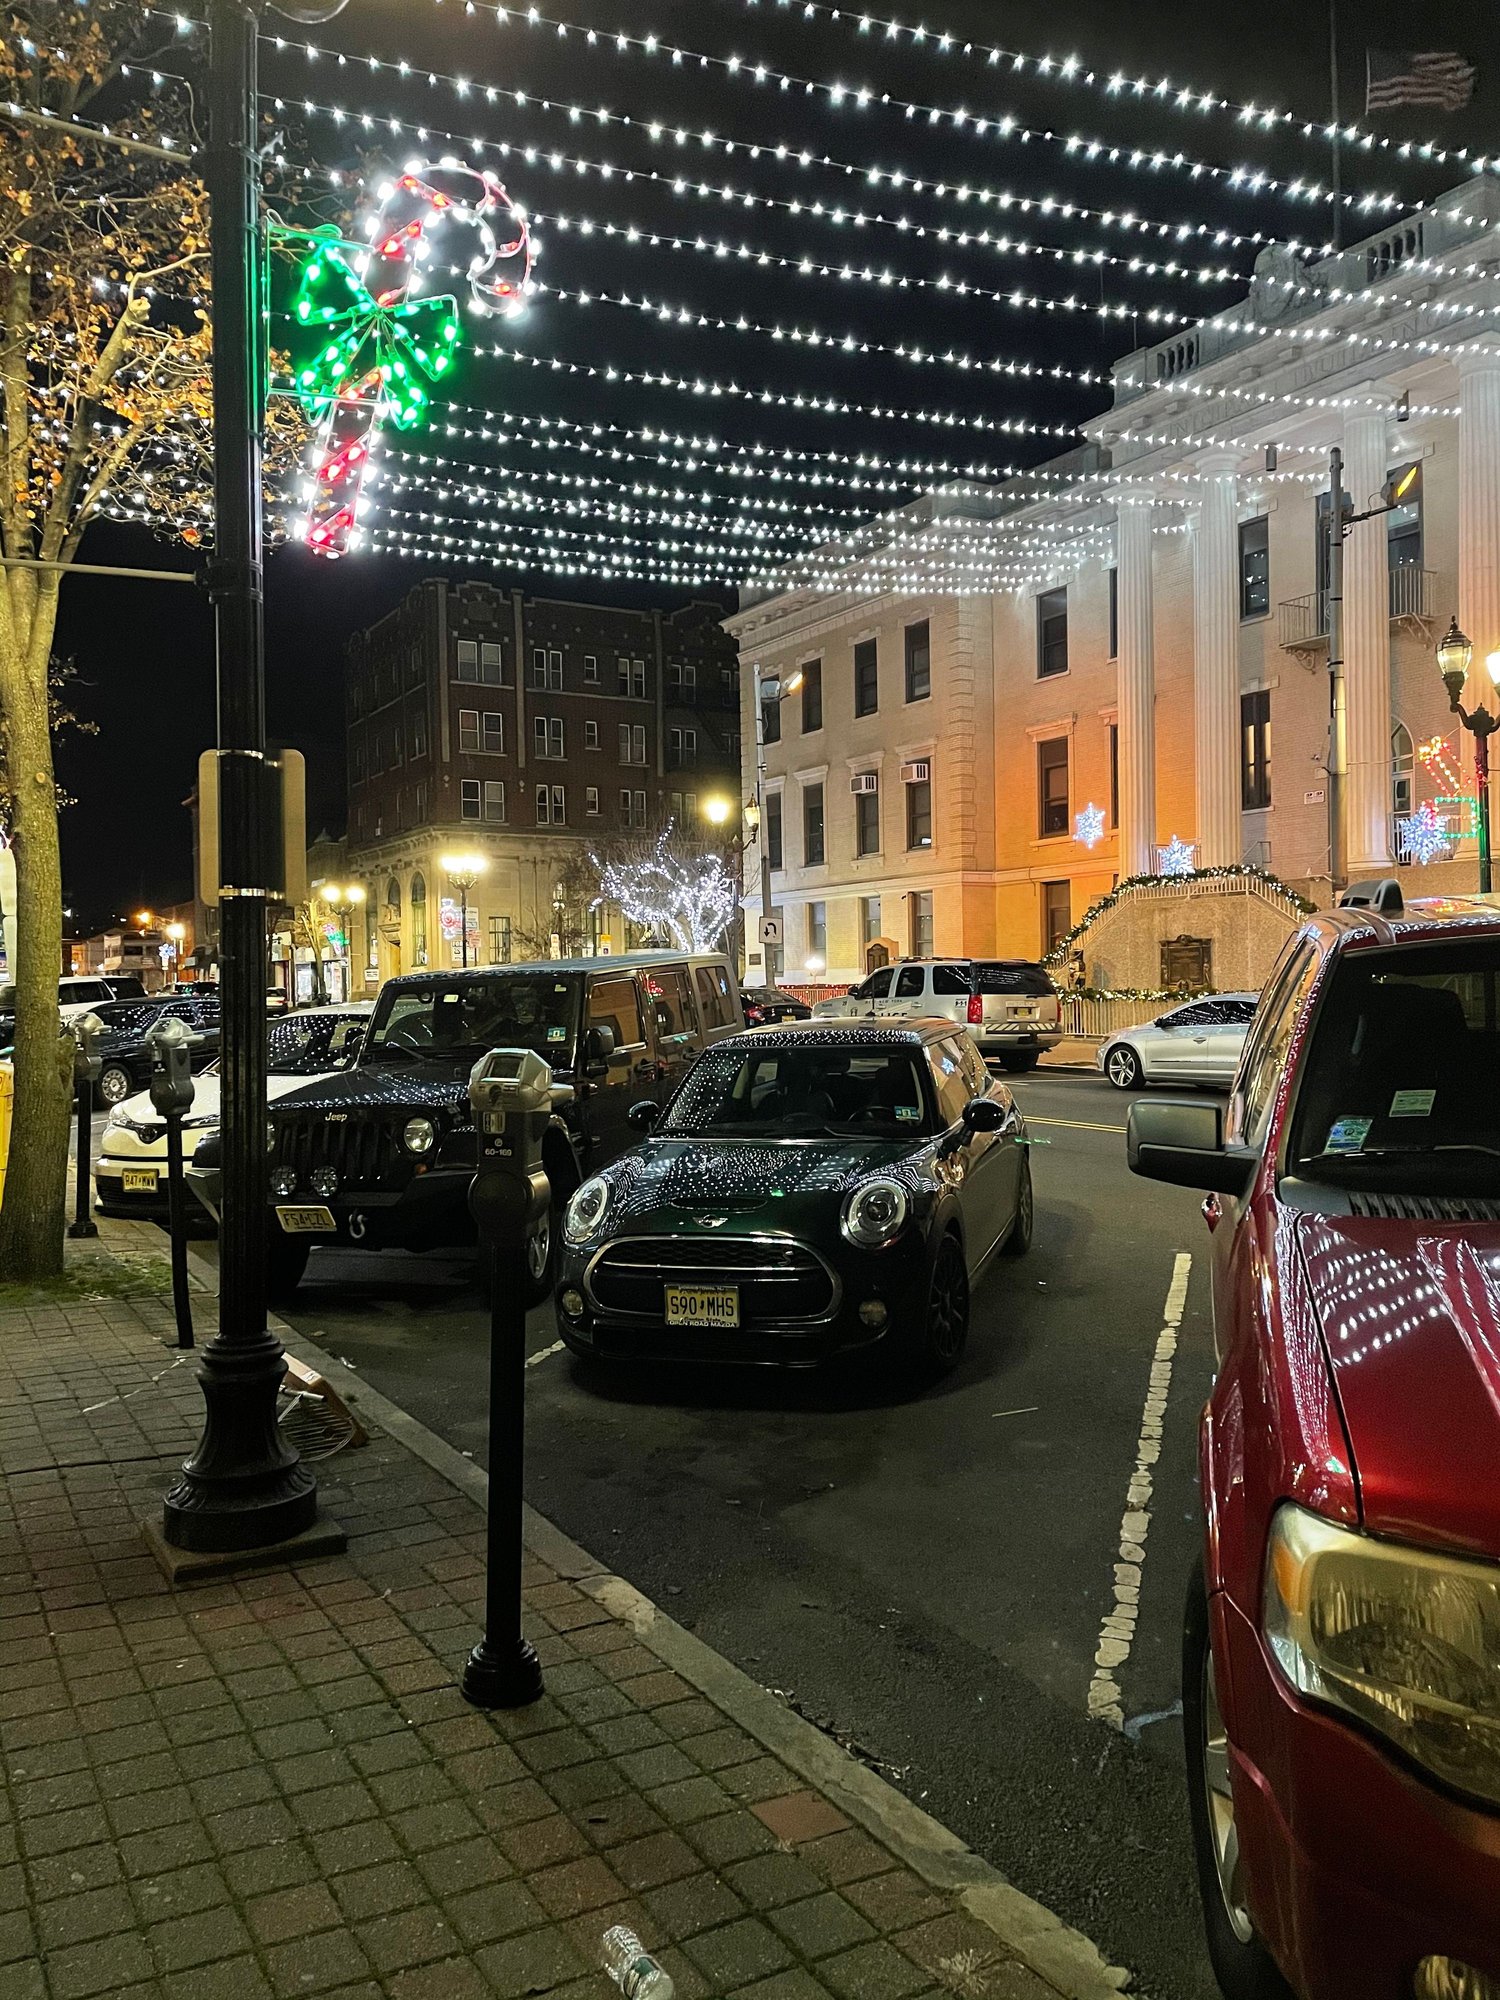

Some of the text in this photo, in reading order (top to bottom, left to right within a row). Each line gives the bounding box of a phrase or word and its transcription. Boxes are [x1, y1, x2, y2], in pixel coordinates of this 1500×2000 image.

[324, 1111, 348, 1123] Jeep
[670, 1295, 734, 1317] S90 MHS
